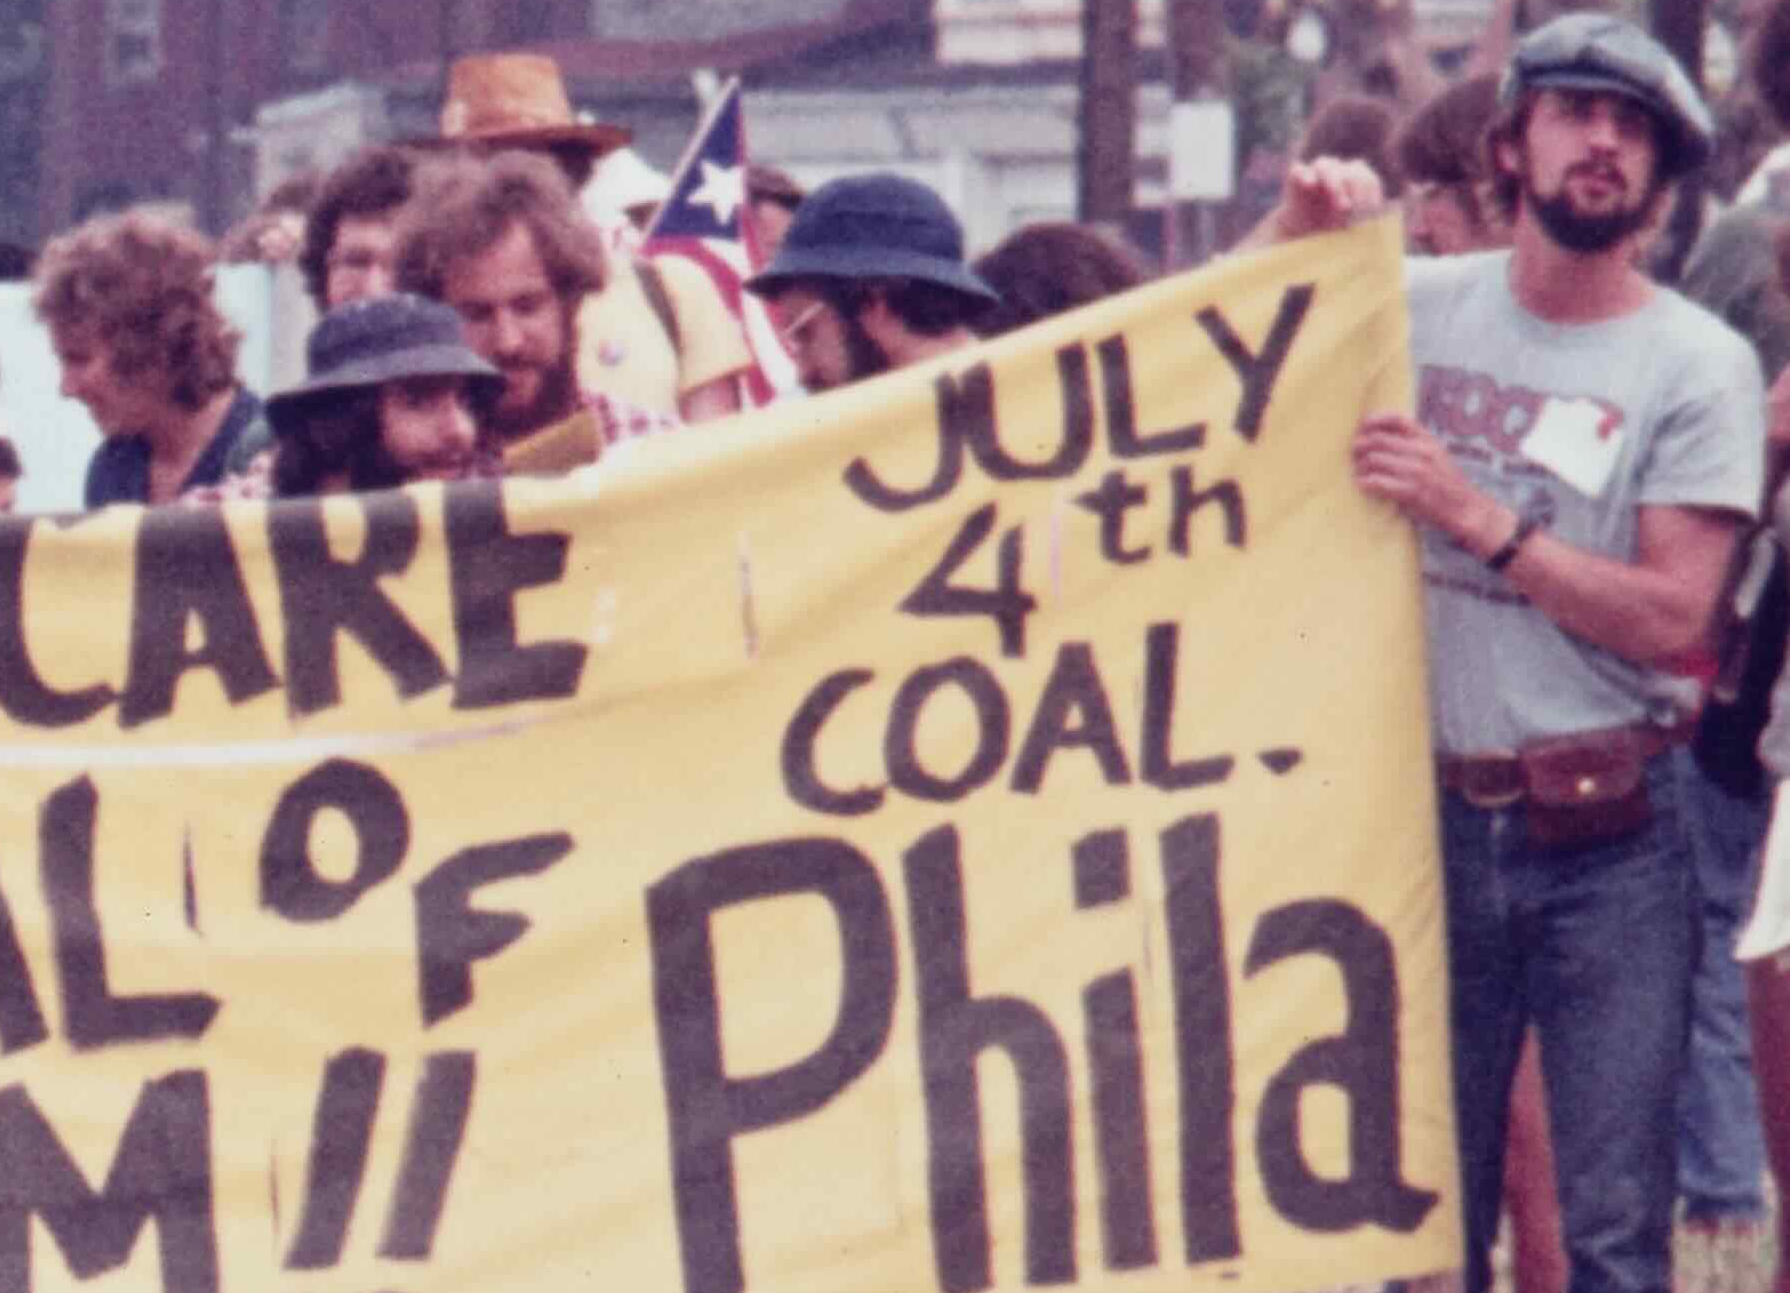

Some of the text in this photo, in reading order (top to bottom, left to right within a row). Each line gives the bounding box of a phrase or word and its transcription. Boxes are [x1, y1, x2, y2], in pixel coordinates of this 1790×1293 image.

[846, 285, 1312, 511] JULY
[902, 466, 1246, 657] 4th
[782, 622, 1300, 816] COAL.
[259, 761, 572, 1026] OF
